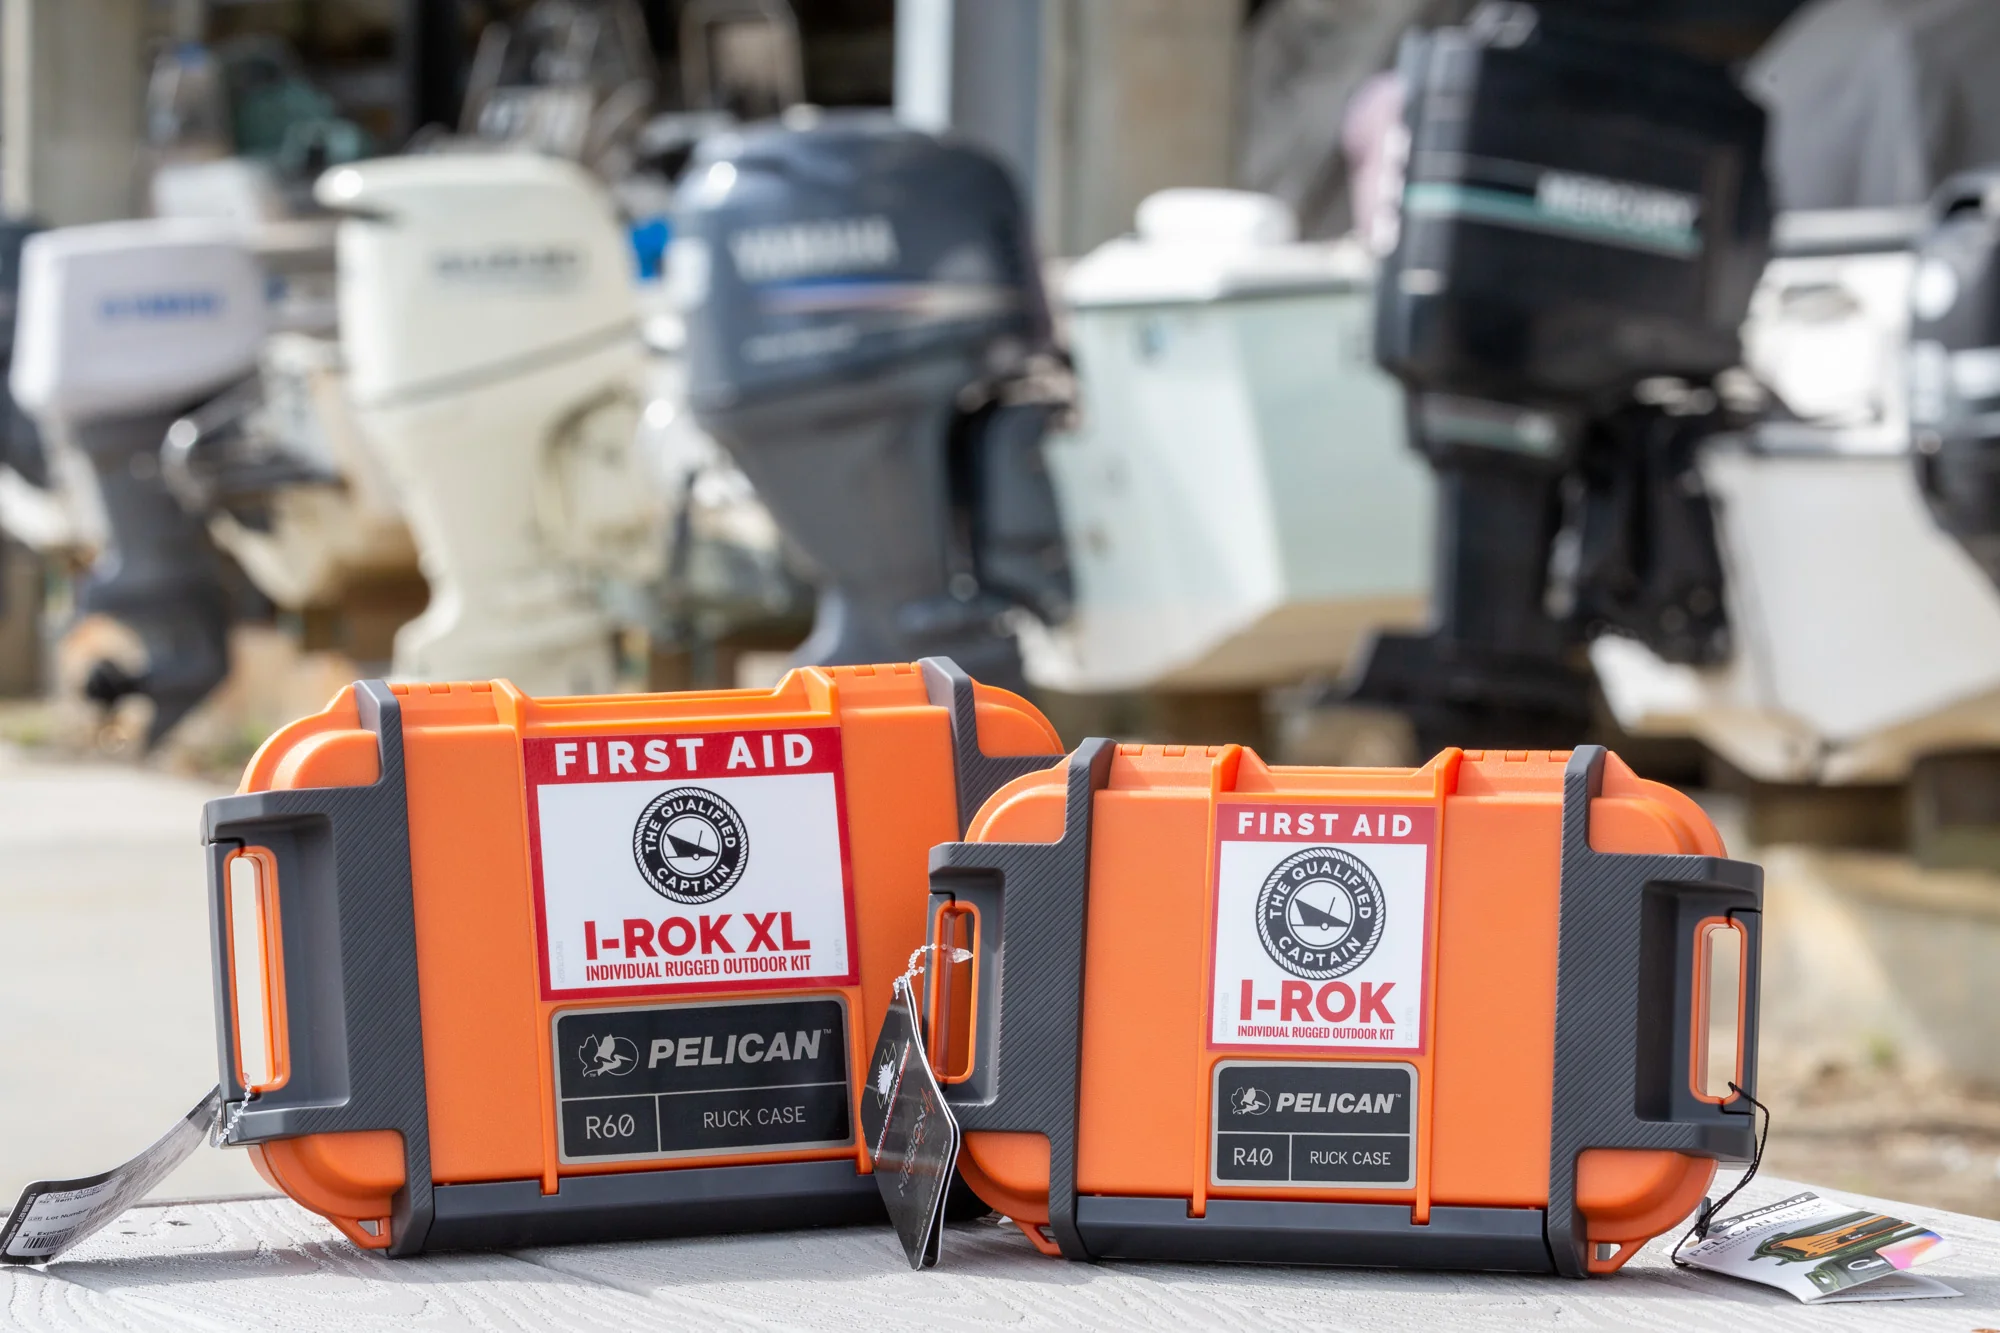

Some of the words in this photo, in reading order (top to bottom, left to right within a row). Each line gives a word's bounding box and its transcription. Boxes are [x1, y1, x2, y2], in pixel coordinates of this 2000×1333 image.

[555, 739, 704, 776] FIRST
[726, 734, 813, 769] AID
[646, 816, 662, 853] THE
[662, 798, 736, 848] QUALIFIED
[1238, 812, 1339, 835] FIRST
[1352, 813, 1413, 837] AID
[656, 864, 731, 892] CAPTAIN
[1270, 879, 1292, 918] THE
[1292, 861, 1372, 919] QUALIFIED
[584, 913, 737, 961] I-ROK
[744, 911, 811, 952] XL
[1278, 936, 1362, 967] CAPTAIN
[586, 960, 662, 981] INDIVIDUAL
[665, 957, 720, 978] RUGGED
[723, 955, 788, 975] OUTDOOR
[791, 954, 812, 972] KIT
[1240, 979, 1396, 1024] I-ROK
[1237, 1025, 1290, 1038] INDIVIDUAL
[1292, 1026, 1330, 1039] RUGGED
[1332, 1027, 1376, 1040] OUTDOOR
[1377, 1028, 1394, 1040] KIT
[648, 1031, 821, 1069] PELICAN
[1276, 1092, 1394, 1114] PELICAN
[586, 1114, 636, 1140] R60
[703, 1108, 753, 1130] RUCK
[757, 1106, 806, 1125] CASE
[1233, 1147, 1273, 1166] R40
[1310, 1150, 1348, 1165] RUCK
[1352, 1151, 1391, 1165] CASE
[1742, 1196, 1808, 1220] PELICAN
[1689, 1219, 1772, 1257] PELICAN
